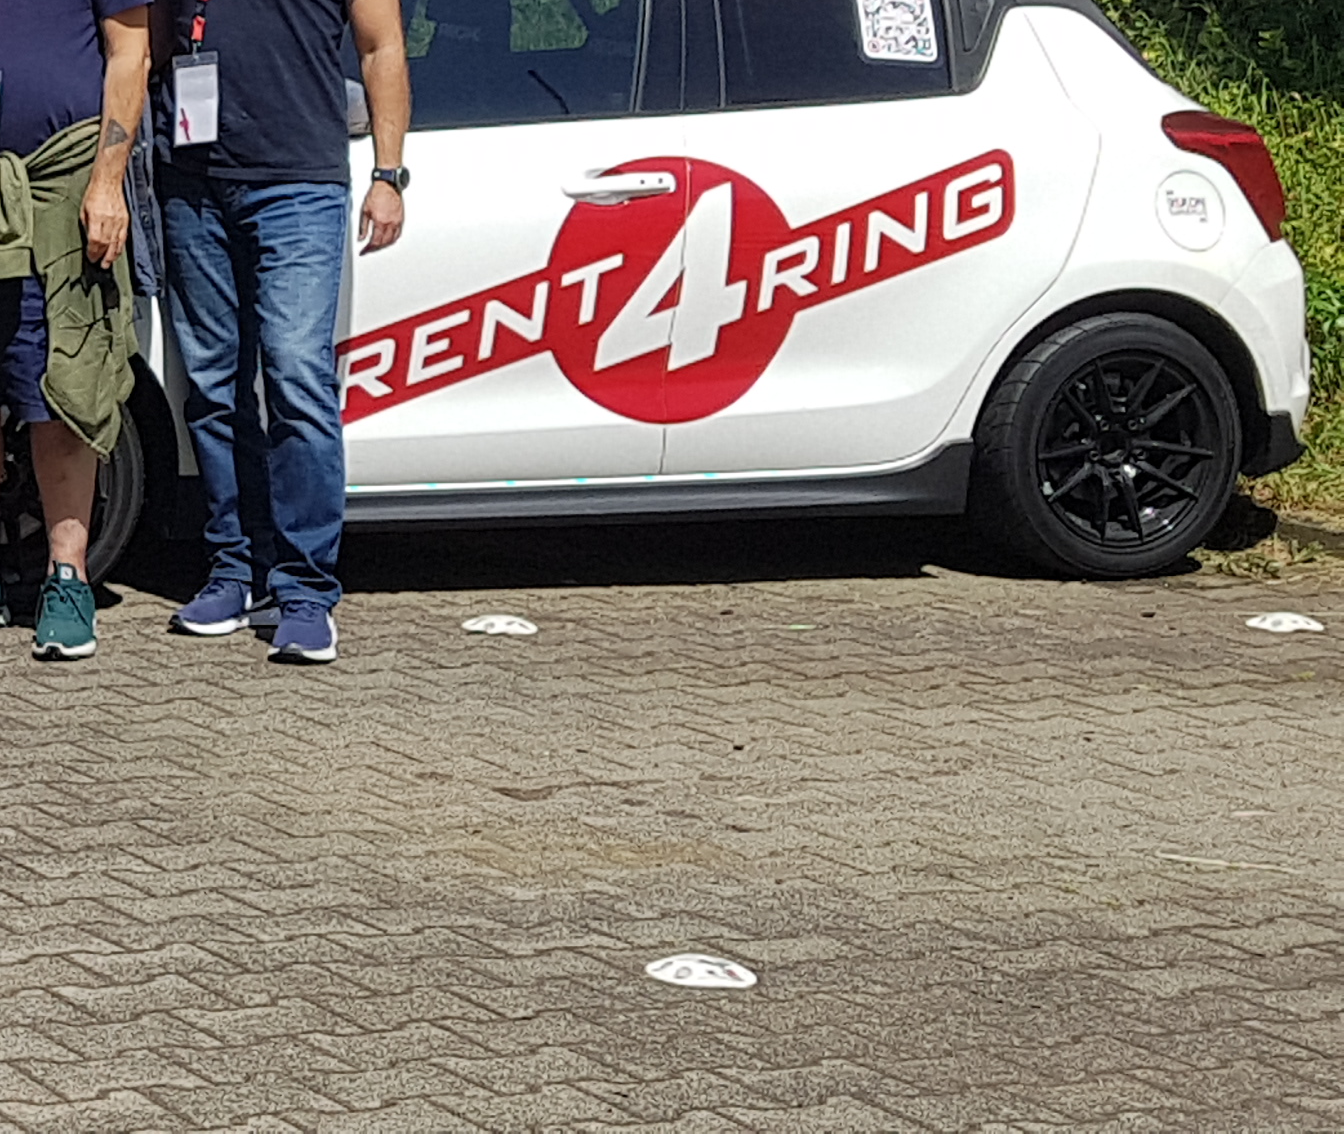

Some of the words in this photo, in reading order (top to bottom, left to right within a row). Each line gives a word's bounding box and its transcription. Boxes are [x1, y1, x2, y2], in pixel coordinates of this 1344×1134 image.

[339, 253, 625, 411] RENT
[592, 181, 748, 372] 4
[756, 162, 1005, 313] RING
